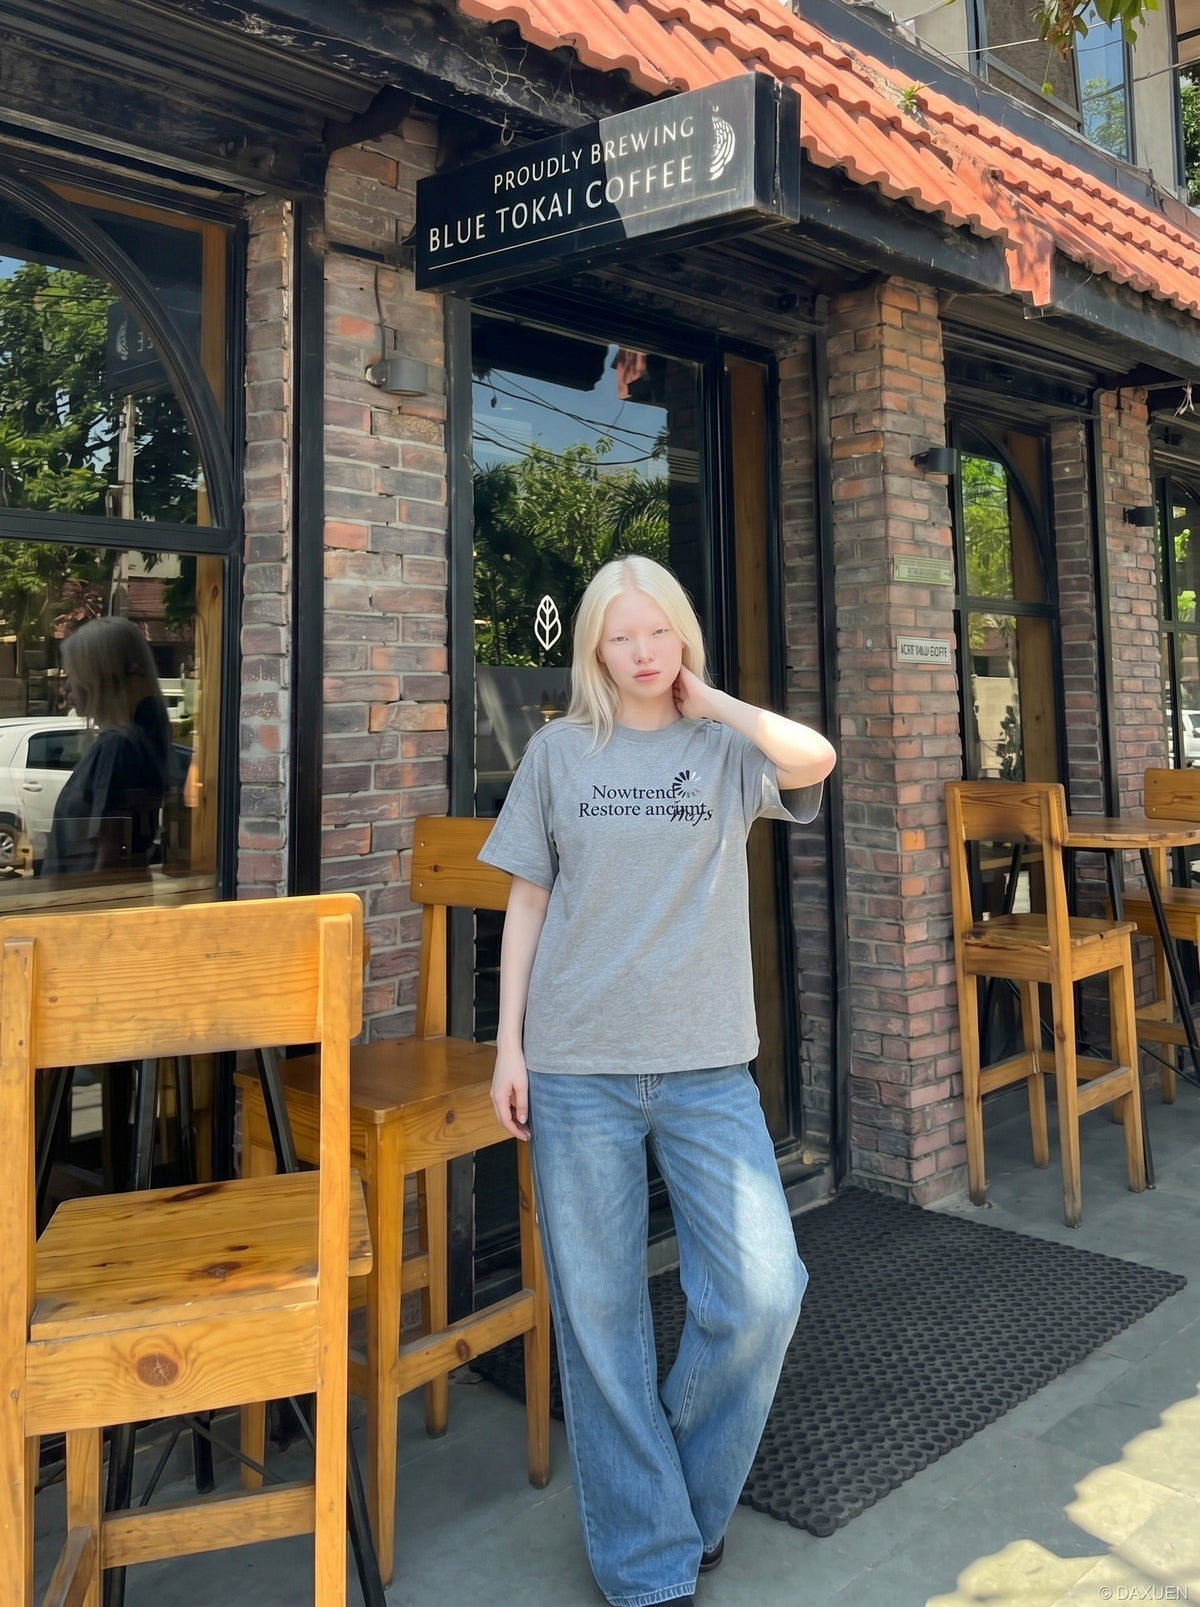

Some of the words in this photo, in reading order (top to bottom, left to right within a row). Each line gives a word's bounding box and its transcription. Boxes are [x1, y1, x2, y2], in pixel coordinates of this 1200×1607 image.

[493, 148, 582, 194] PROUDLY
[590, 116, 694, 163] BREWING
[429, 212, 486, 252] BLUE
[496, 187, 573, 234] TOKAI
[585, 155, 693, 209] COFFEE
[578, 803, 641, 818] Restore
[592, 785, 677, 799] Nowtrend
